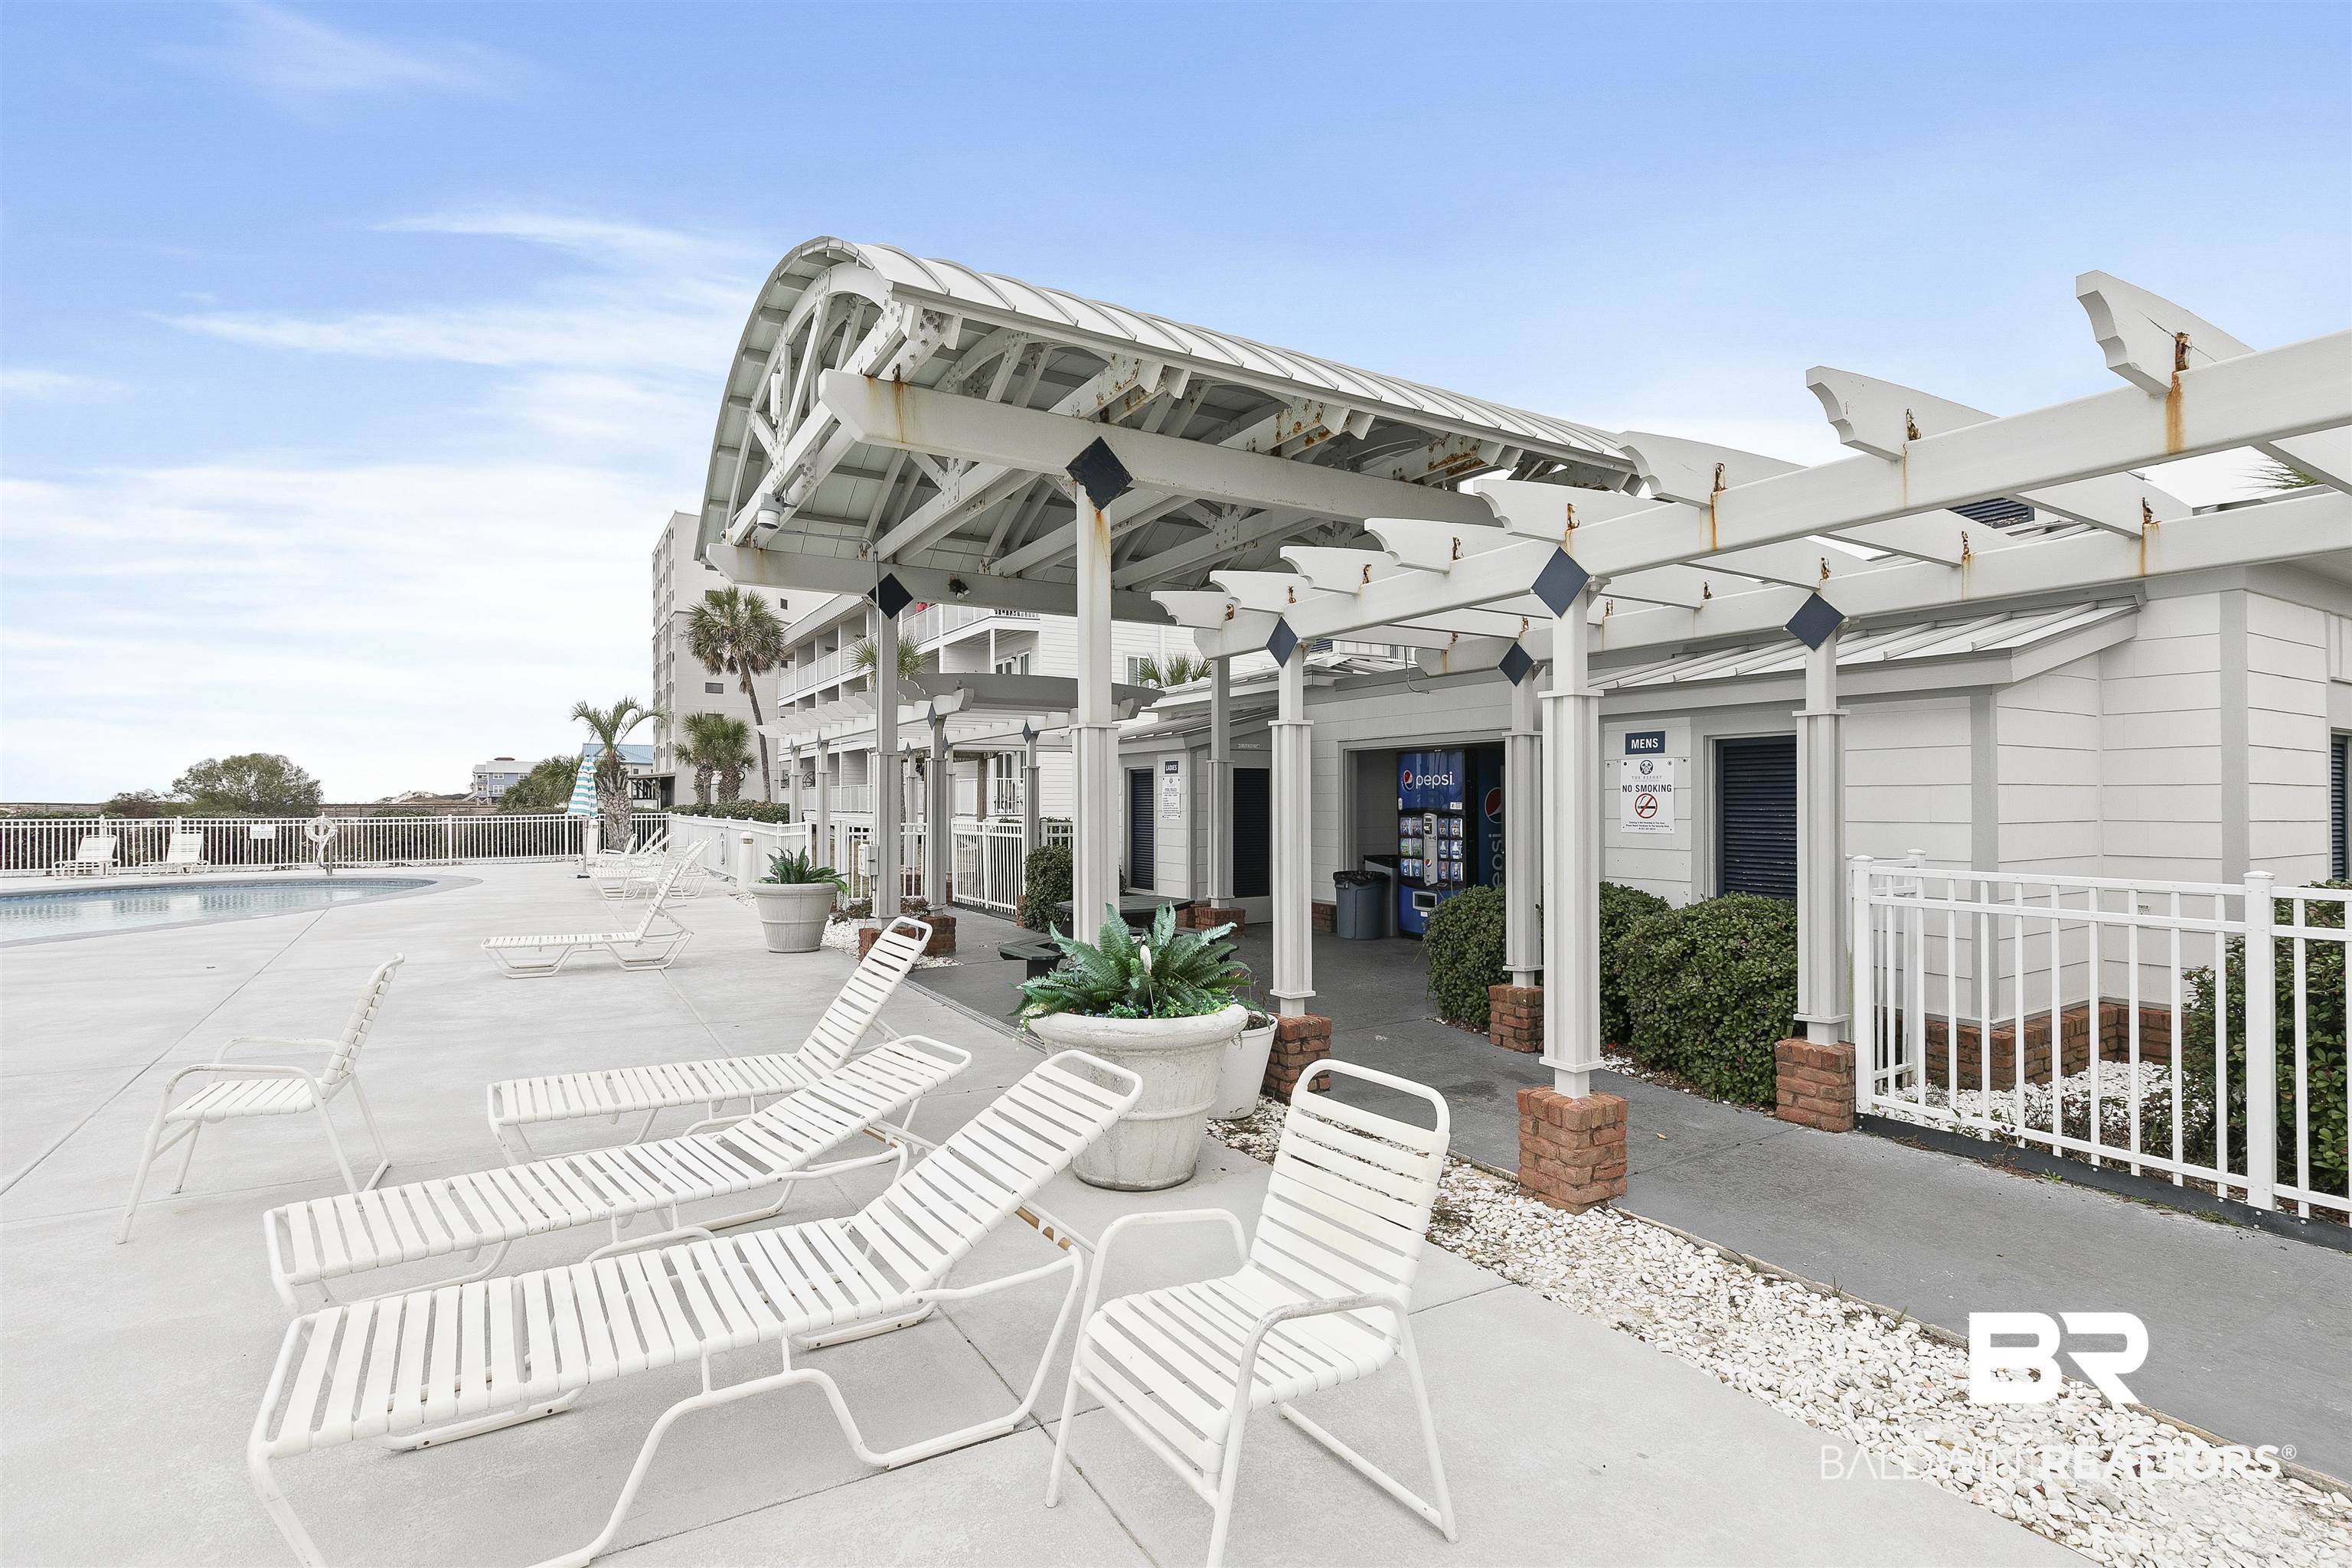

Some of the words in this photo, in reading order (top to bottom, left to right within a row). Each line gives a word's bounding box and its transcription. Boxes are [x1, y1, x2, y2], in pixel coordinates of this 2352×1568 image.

[1631, 738, 1658, 749] MENS
[1416, 771, 1452, 789] pepsi
[1622, 784, 1632, 792] NO
[1635, 784, 1672, 792] SMOKING
[1488, 833, 1502, 887] epsi
